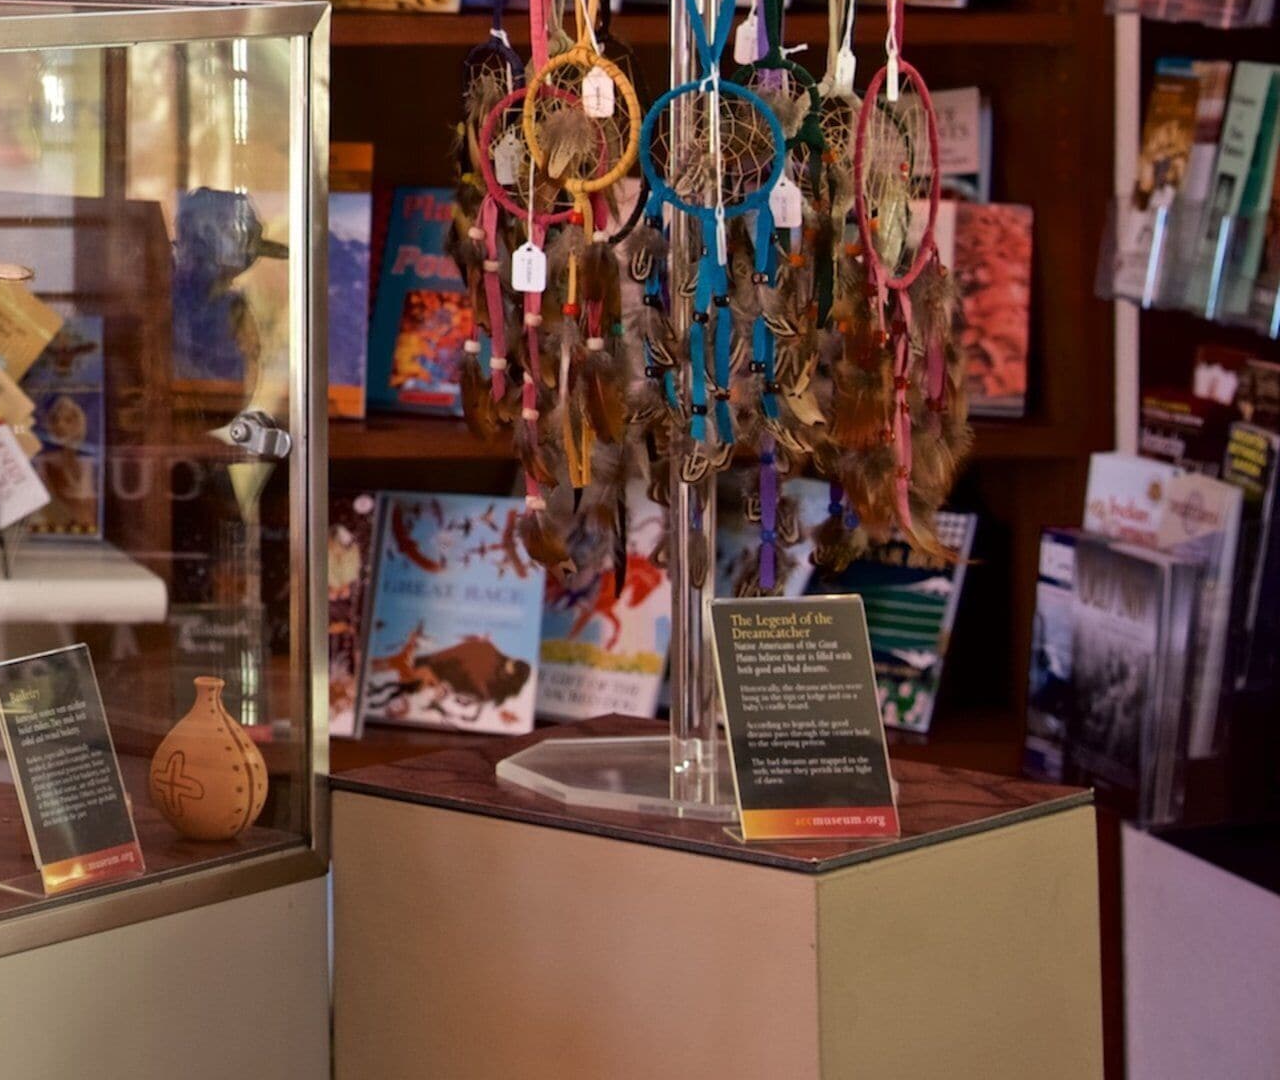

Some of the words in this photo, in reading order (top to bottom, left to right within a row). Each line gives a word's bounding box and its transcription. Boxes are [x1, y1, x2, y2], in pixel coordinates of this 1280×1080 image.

[730, 613, 752, 627] The
[755, 612, 798, 631] Legend
[799, 612, 812, 625] of
[813, 612, 833, 625] the
[732, 626, 811, 640] Dreamcatcher
[758, 652, 782, 662] believe
[783, 652, 795, 662] the
[835, 651, 853, 661] with
[736, 664, 754, 675] both
[754, 664, 772, 677] good
[772, 663, 787, 674] and
[787, 663, 801, 674] bad
[794, 813, 887, 828] accmuseum.org
